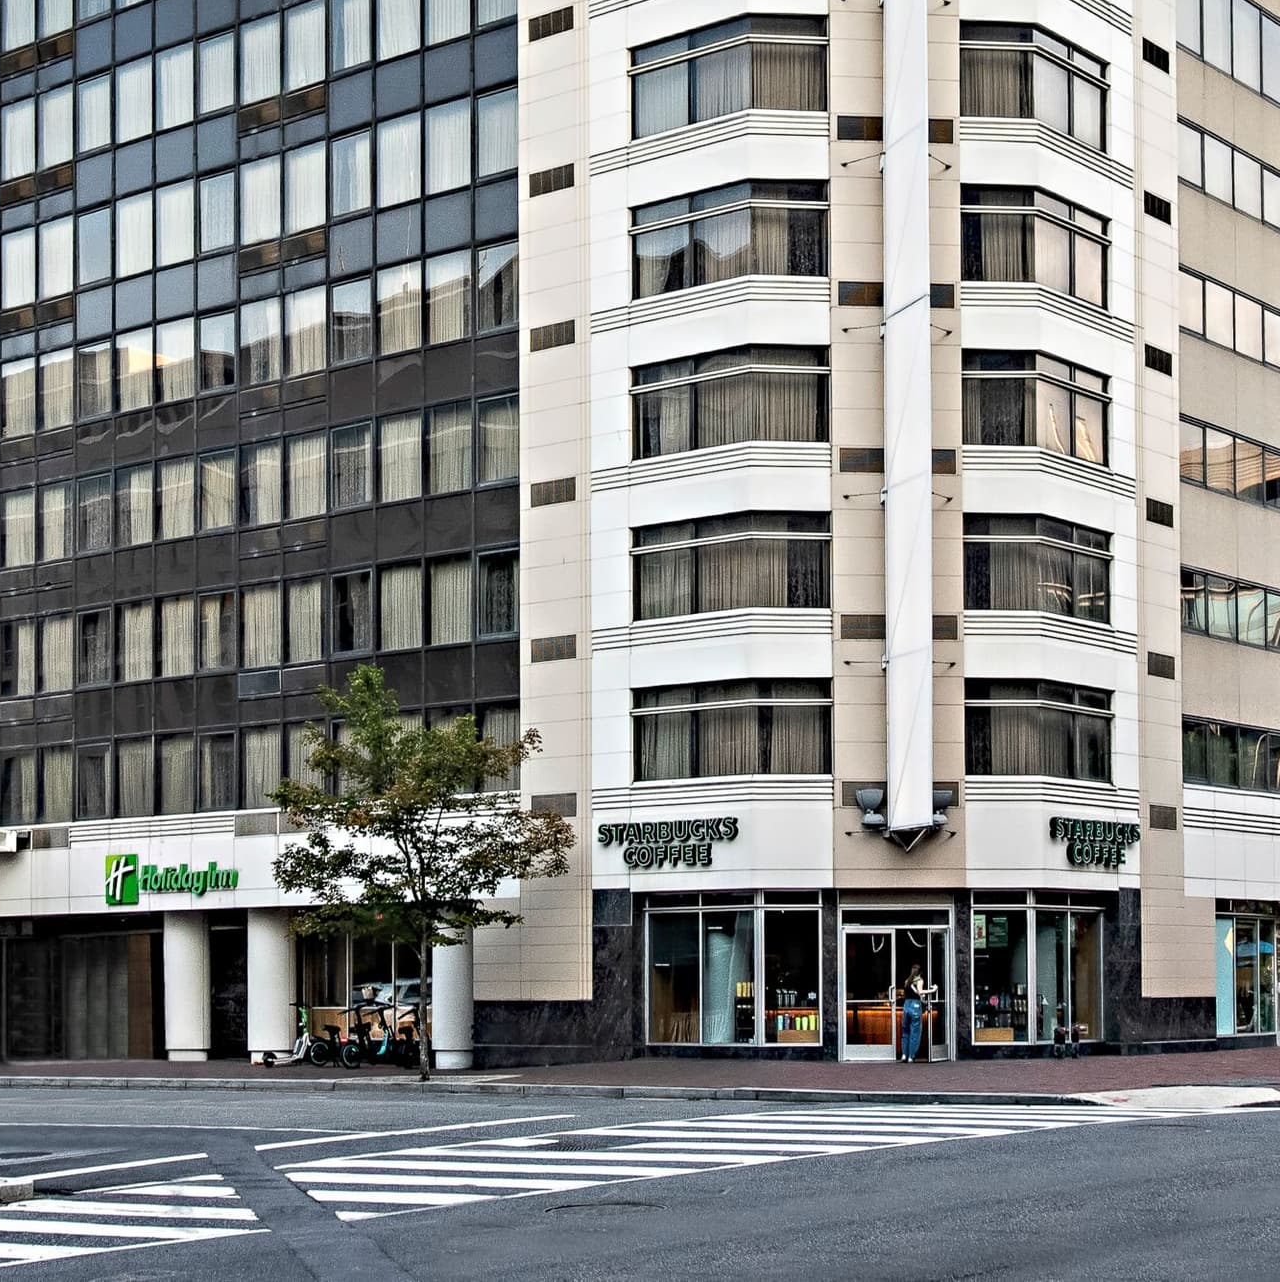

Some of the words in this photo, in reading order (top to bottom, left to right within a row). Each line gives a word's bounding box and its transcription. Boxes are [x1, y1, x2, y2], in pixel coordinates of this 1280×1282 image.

[598, 817, 739, 846] STARBUCKS
[1051, 817, 1140, 843] STARBUCKS
[624, 842, 712, 868] COFFEE
[1069, 842, 1126, 868] COFFEE
[140, 864, 207, 896] Holiday
[208, 861, 239, 890] Inn
